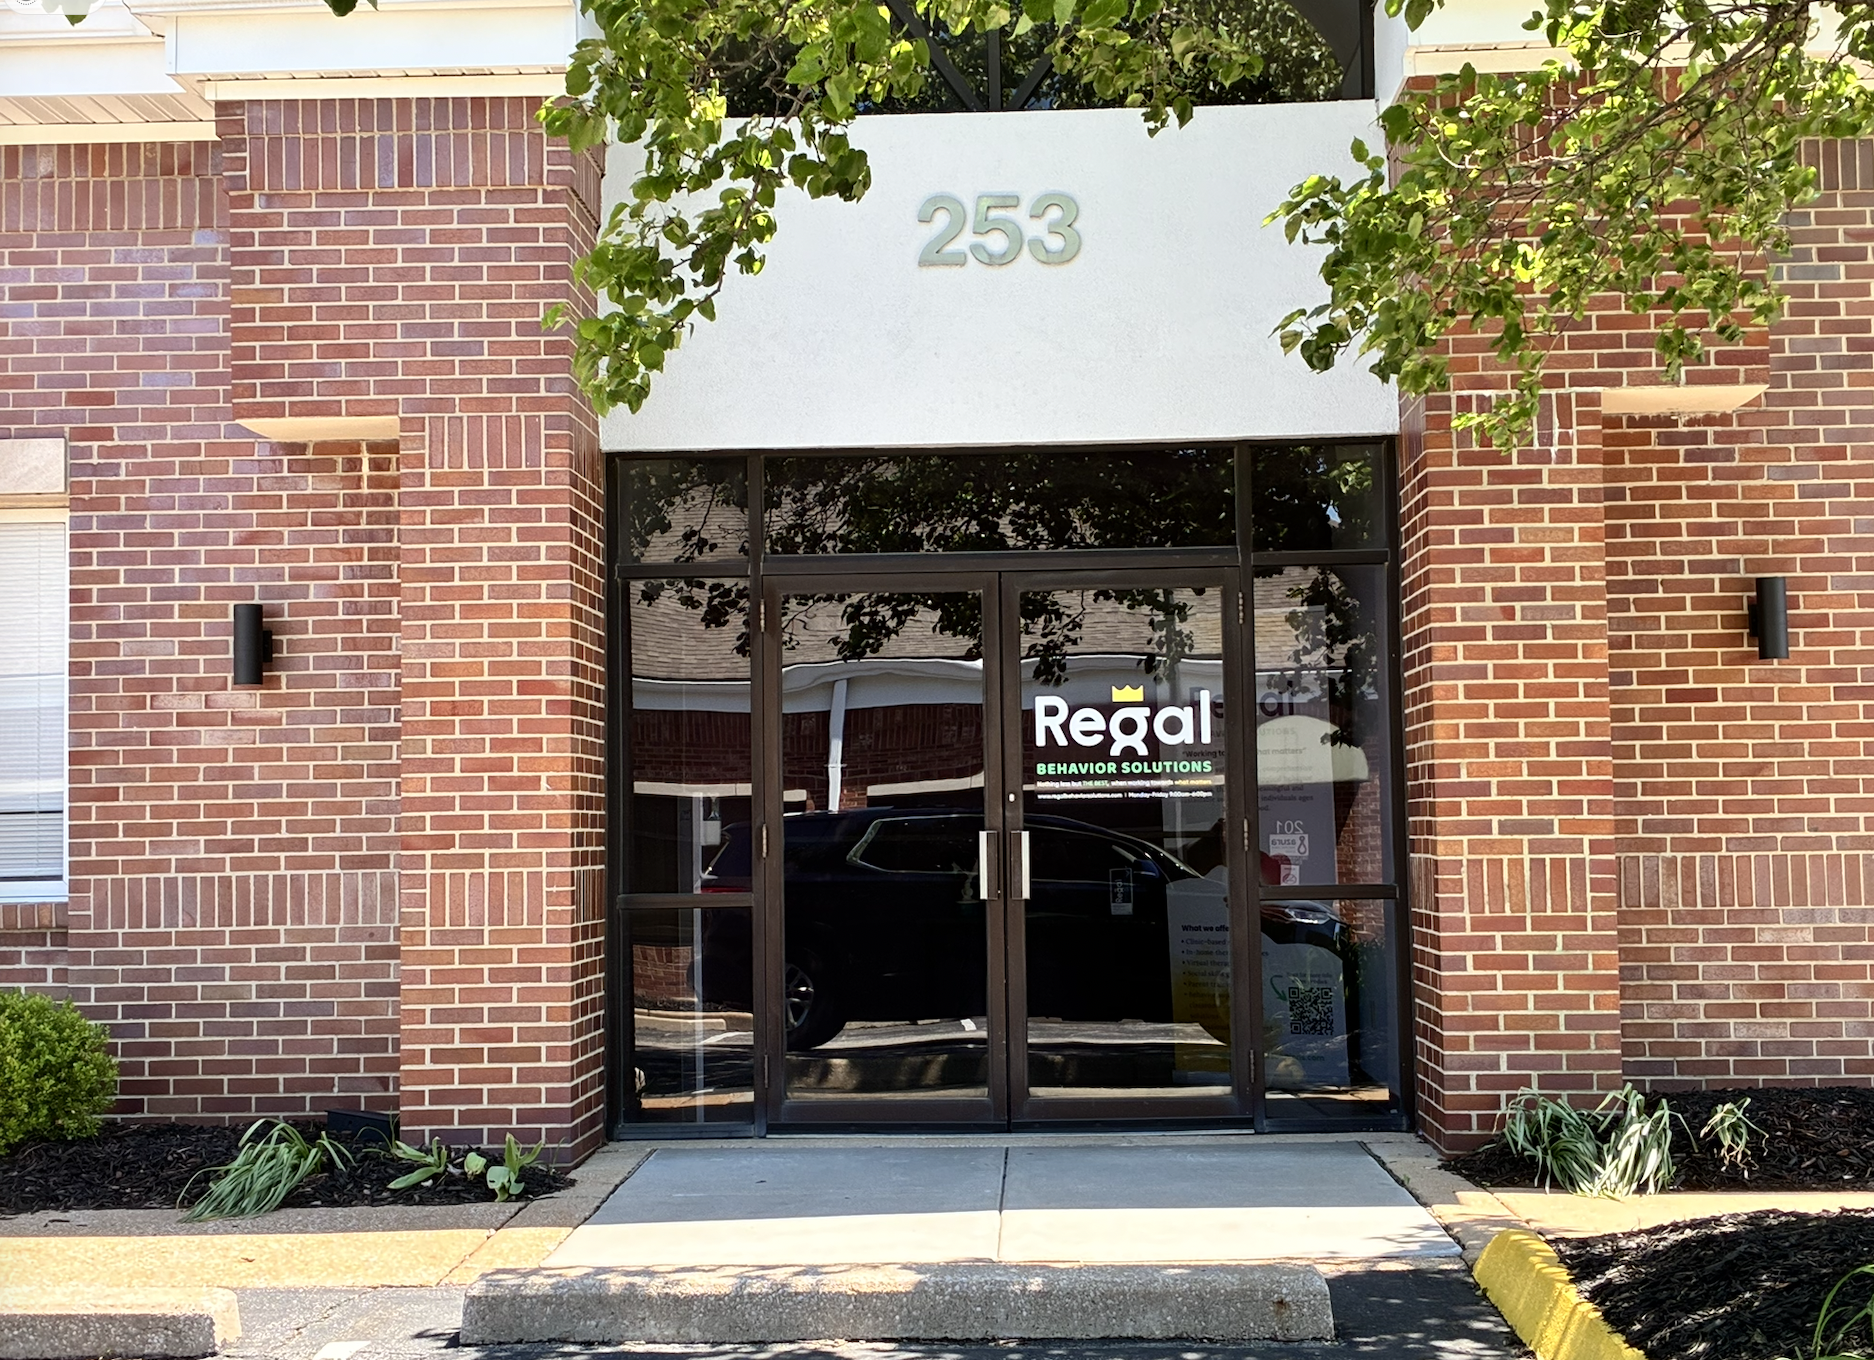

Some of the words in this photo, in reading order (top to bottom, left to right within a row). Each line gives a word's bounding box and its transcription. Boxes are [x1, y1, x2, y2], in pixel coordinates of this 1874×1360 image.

[918, 193, 1081, 267] 253
[1034, 690, 1212, 756] Regal
[1036, 762, 1117, 775] BEHAVIOR
[1121, 760, 1212, 773] SOLUTIONS
[1181, 924, 1202, 932] What
[1215, 924, 1230, 932] offe
